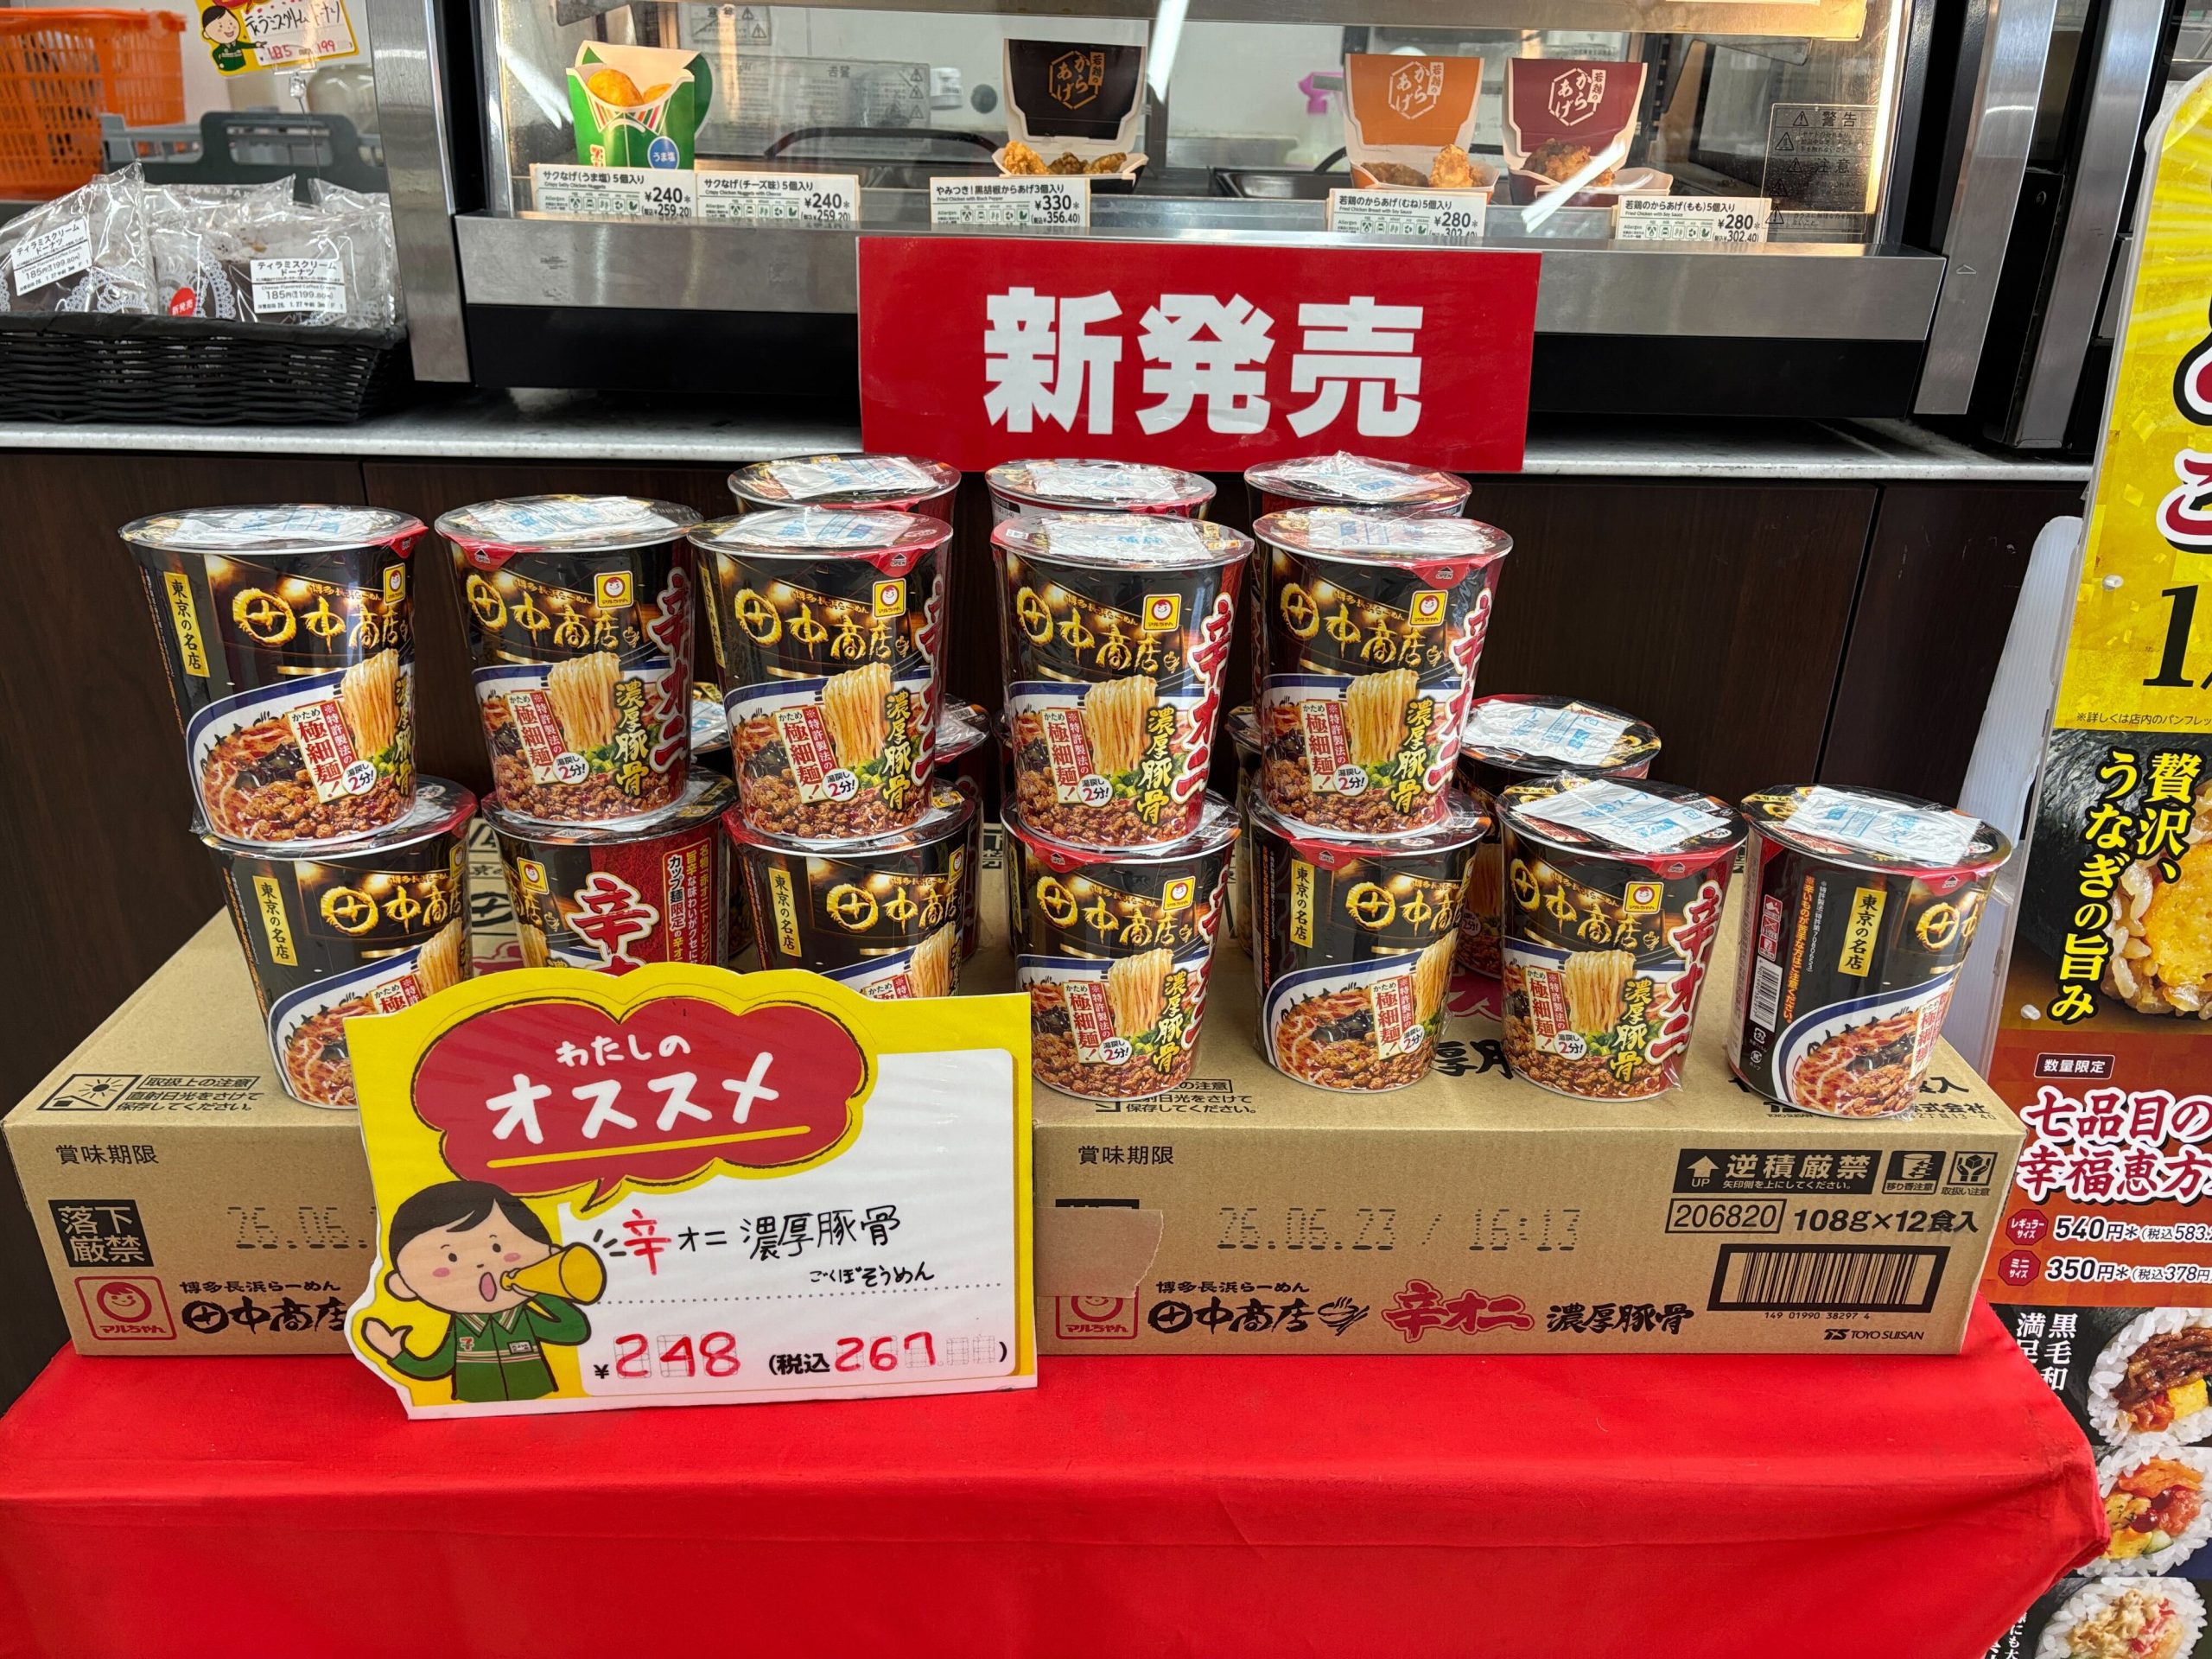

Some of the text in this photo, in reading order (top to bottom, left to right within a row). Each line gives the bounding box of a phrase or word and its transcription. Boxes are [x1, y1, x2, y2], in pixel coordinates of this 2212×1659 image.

[652, 150, 676, 162] うま塩
[613, 174, 645, 185] 5個入り
[782, 181, 813, 191] 5個入り
[17, 224, 79, 256] ティラミスクリーム
[36, 238, 63, 255] ドーナツ
[257, 260, 337, 270] ティラミスクリーム
[982, 286, 1424, 438] 新発売
[232, 588, 400, 655] 田中商店
[467, 575, 620, 649] 田中商店
[734, 588, 894, 661] 田中商店
[1281, 582, 1427, 667] 田中商店
[171, 580, 202, 672] 東京の名店
[1016, 588, 1161, 675] 田中商店
[509, 695, 531, 704] かため
[1303, 703, 1325, 714] かため
[291, 708, 321, 722] かため
[779, 712, 803, 721] かため
[1044, 713, 1065, 722] かため
[515, 704, 552, 781] 極細麺!
[615, 680, 649, 795] 濃厚豚骨
[296, 721, 343, 798] 極細麺!
[784, 721, 821, 801] 極細麺!
[883, 694, 912, 809] 濃厚豚骨
[1047, 721, 1078, 802] 極細麺!
[1306, 713, 1335, 791] 極細麺!
[1390, 700, 1432, 812] 濃厚豚骨
[560, 763, 586, 779] 2分!
[1137, 706, 1173, 823] 濃厚豚骨
[349, 772, 374, 792] 2分!
[830, 779, 855, 797] 2分!
[1082, 786, 1109, 802] 2分!
[1338, 776, 1365, 791] 2分!
[2137, 752, 2204, 880] 贅沢、
[2051, 750, 2139, 1021] うなぎの旨み
[774, 874, 795, 950] 東京の名店
[1037, 875, 1179, 946] 田中商店
[1294, 868, 1310, 940] 東京の名店
[1510, 858, 1642, 950] 田中商店
[261, 882, 290, 961] 東京の名店
[1843, 893, 1881, 970] 東京の名店
[1527, 969, 1546, 979] かため
[373, 983, 400, 998] かため
[868, 982, 893, 995] かため
[1065, 984, 1088, 993] かため
[1373, 982, 1396, 993] かため
[1069, 993, 1098, 1060] 極細麺!
[1153, 972, 1188, 1072] 濃厚豚骨
[1376, 993, 1399, 1057] 極細麺!
[1529, 979, 1554, 1050] 極細麺!
[1403, 1035, 1423, 1051] 2分!
[1610, 978, 1655, 1083] 濃厚豚骨
[556, 1034, 692, 1068] わたしの
[1103, 1047, 1129, 1060] 2分!
[1558, 1041, 1584, 1055] 2分!
[2043, 1058, 2106, 1074] 数量限定
[145, 1077, 251, 1089] 取扱上の注意
[115, 1102, 253, 1112] 保存してください。
[125, 1090, 264, 1102] 直射日光をさけて
[485, 1051, 781, 1146] オススメ
[1126, 1103, 1256, 1115] 保存してください。
[2025, 1090, 2212, 1141] 七品目の
[54, 1145, 160, 1166] 賞味期限
[1077, 1145, 1175, 1166] 賞味期限
[1726, 1154, 1872, 1180] 逆積厳禁
[1691, 1178, 1711, 1188] UP
[2018, 1144, 2212, 1198] 幸福恵方
[1722, 1180, 1853, 1191] 矢印側を上にしてください。
[1885, 1182, 1933, 1192] 移り香注意
[1942, 1186, 1991, 1198] 取扱い注意
[57, 1205, 135, 1234] 落下
[1216, 1206, 1580, 1252] 26.06.23 16:13
[1674, 1204, 1778, 1229] 206820
[1793, 1208, 1980, 1233] 108g×12食入
[2011, 1218, 2045, 1230] レギュラー
[621, 1204, 901, 1277] 辛オニ 濃厚豚骨
[2017, 1229, 2036, 1240] サイズ
[69, 1236, 146, 1263] 厳禁
[2009, 1268, 2028, 1279] サイズ
[2011, 1258, 2030, 1268] ミニ
[179, 1281, 341, 1294] 博多長浜らーめん
[1155, 1281, 1310, 1294] 博多長浜らーめん
[181, 1295, 346, 1335] 田中商店
[1147, 1295, 1315, 1335] 田中商店
[1382, 1278, 1535, 1343] 辛オニ
[1546, 1301, 1694, 1336] 濃厚豚骨
[1764, 1311, 1859, 1320] 149 01990 38297
[99, 1324, 168, 1335] マルちゃん
[1065, 1323, 1128, 1334] マルちゃん
[1851, 1329, 1924, 1341] TOYO SUISAN
[2043, 1313, 2079, 1391] 黒毛和
